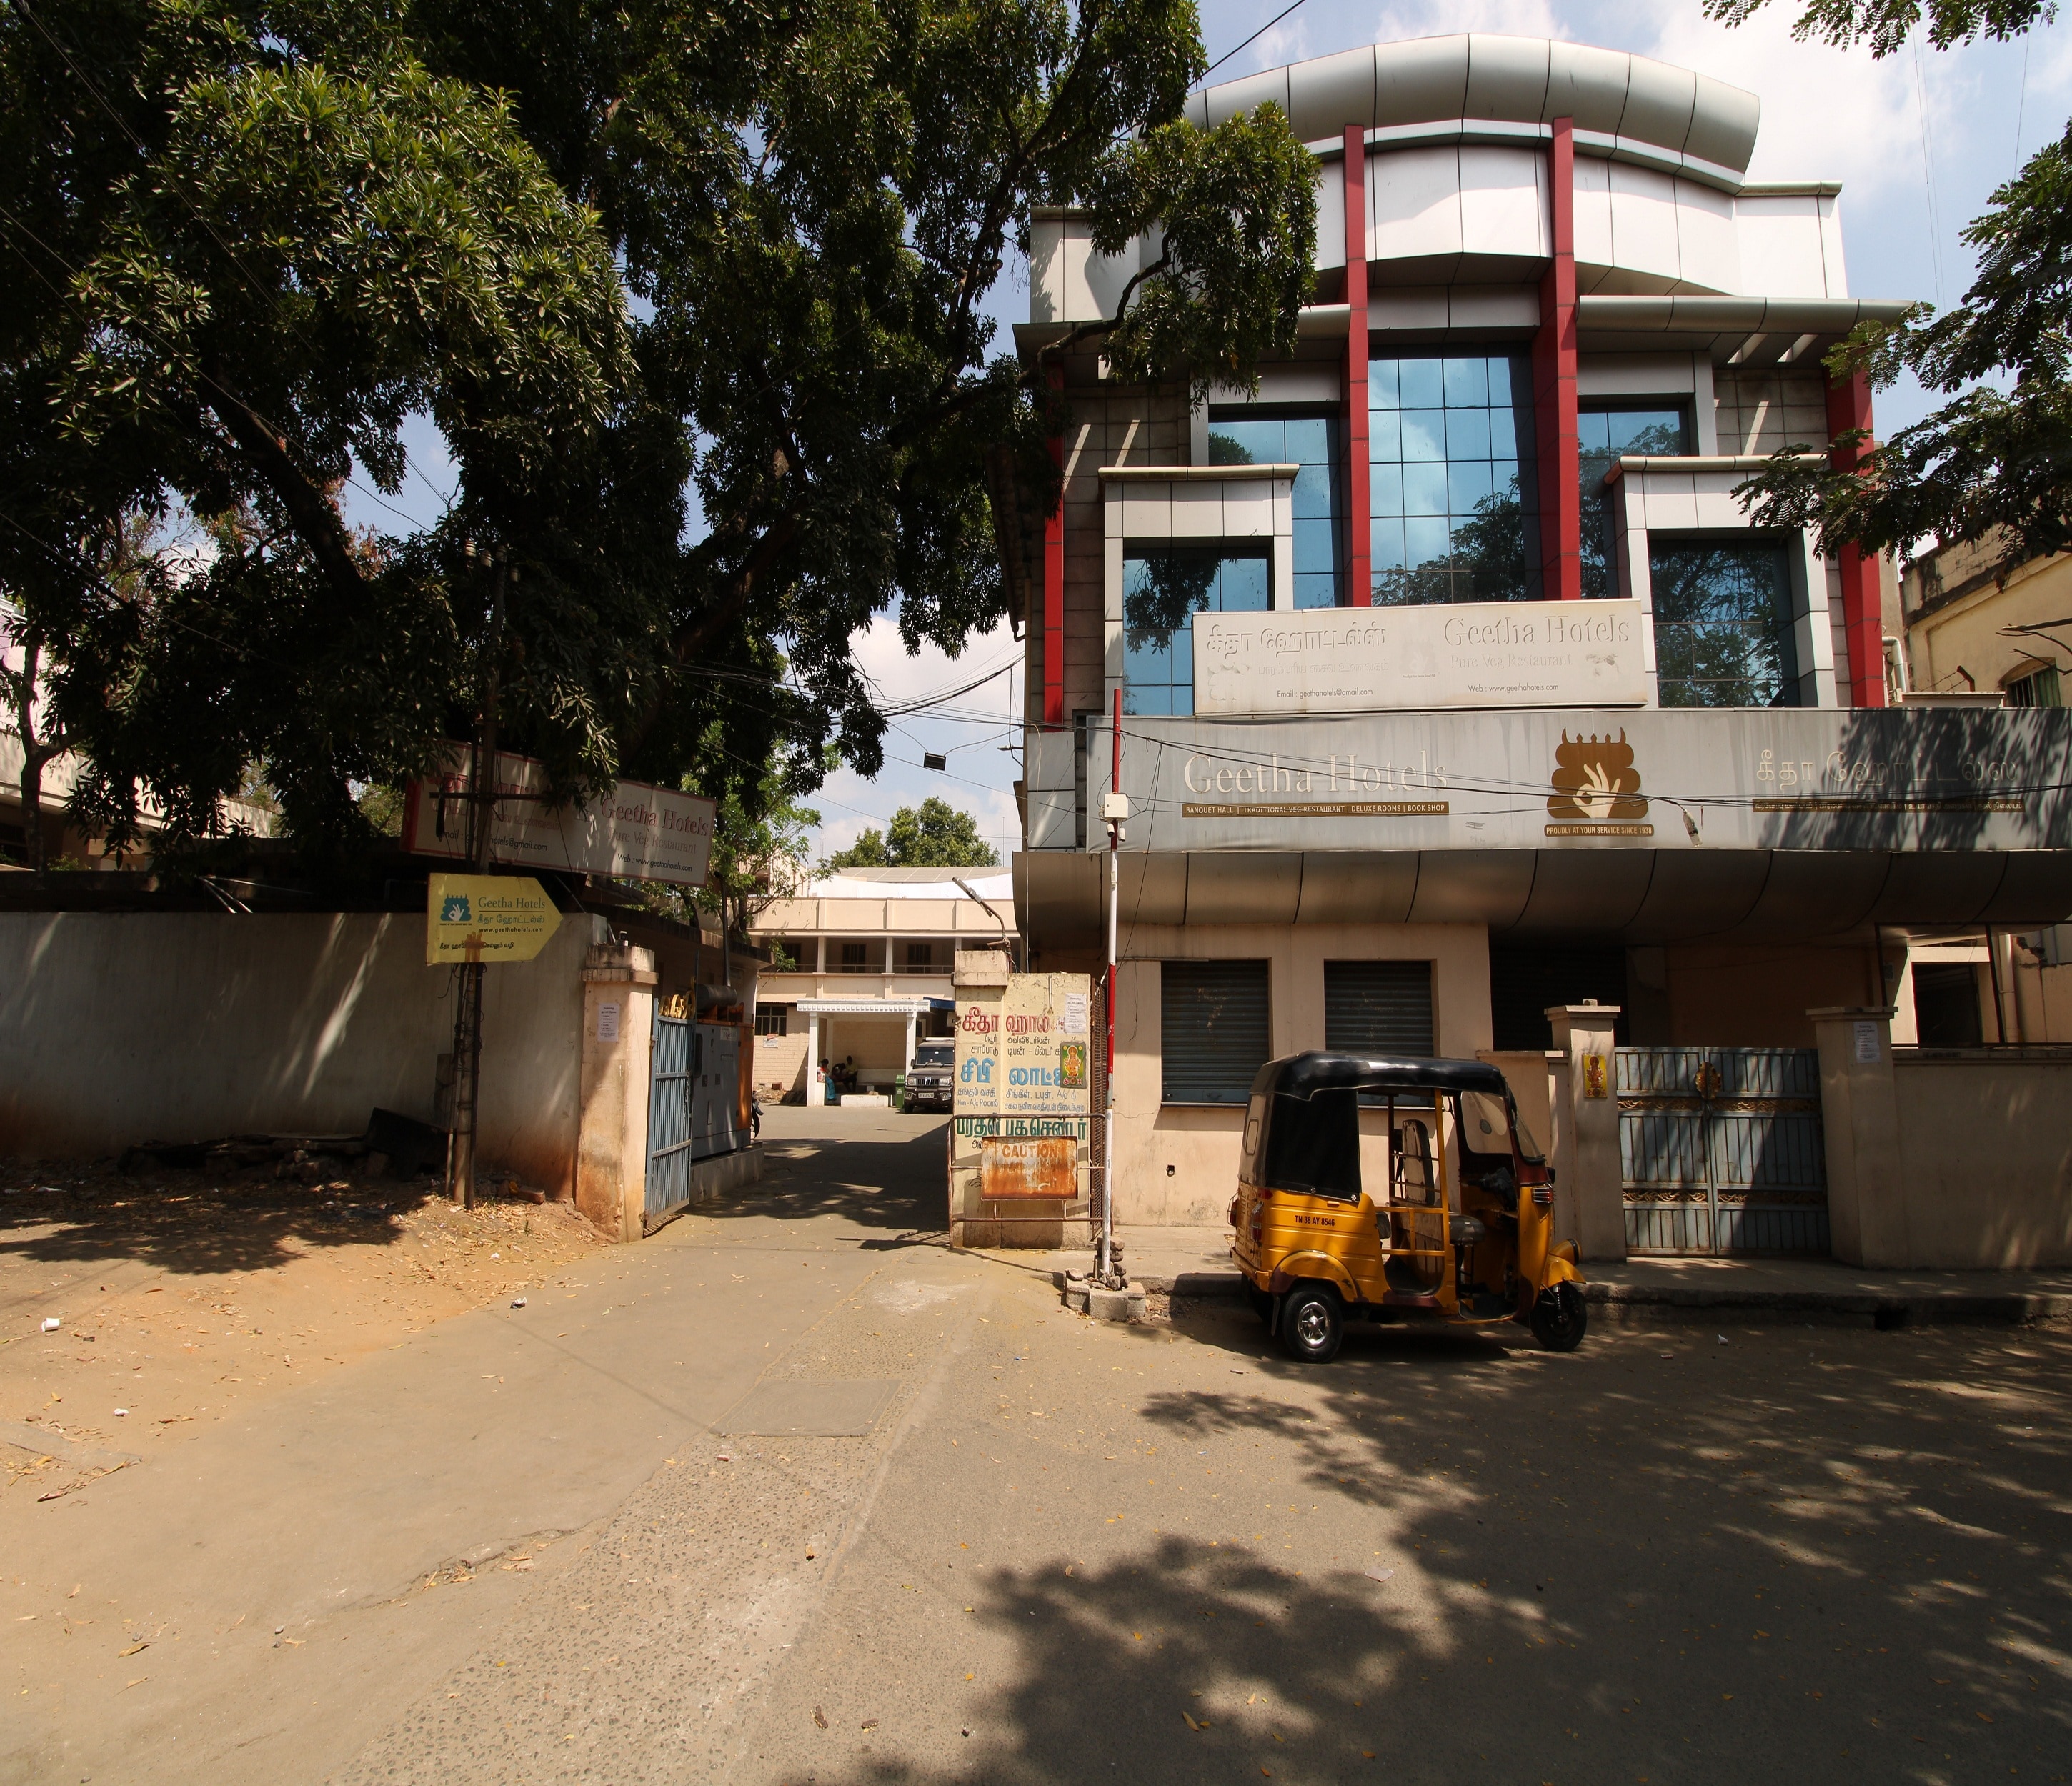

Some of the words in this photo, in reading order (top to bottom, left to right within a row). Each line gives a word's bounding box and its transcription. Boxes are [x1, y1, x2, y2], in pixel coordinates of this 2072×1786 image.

[1444, 617, 1535, 646] Geetha
[1545, 614, 1630, 643] Hotels
[1450, 654, 1478, 669] Pure
[1482, 654, 1504, 670] Veg
[1508, 653, 1573, 667] Restaurant
[1277, 689, 1294, 698] Email
[1299, 688, 1373, 699] geethahotels@gmail.com
[1468, 684, 1483, 692] Web
[1489, 683, 1559, 694] www.geethahotels.com
[1183, 752, 1314, 794] Geetha
[1328, 750, 1448, 792] Hotels
[1756, 749, 1814, 790] கீதா
[601, 797, 657, 827] Geetha
[662, 809, 709, 837] Hotels
[608, 827, 630, 842] Pure
[634, 831, 649, 848] Veg
[652, 835, 697, 854] Restaurant
[617, 854, 631, 863] Web
[635, 857, 692, 872] www.geethahotels.com
[479, 897, 512, 909] Geetha
[516, 897, 546, 909] Hotels
[962, 1006, 1000, 1035] கீதா
[1002, 1144, 1059, 1159] CAUTION
[1321, 1217, 1335, 1226] 8546
